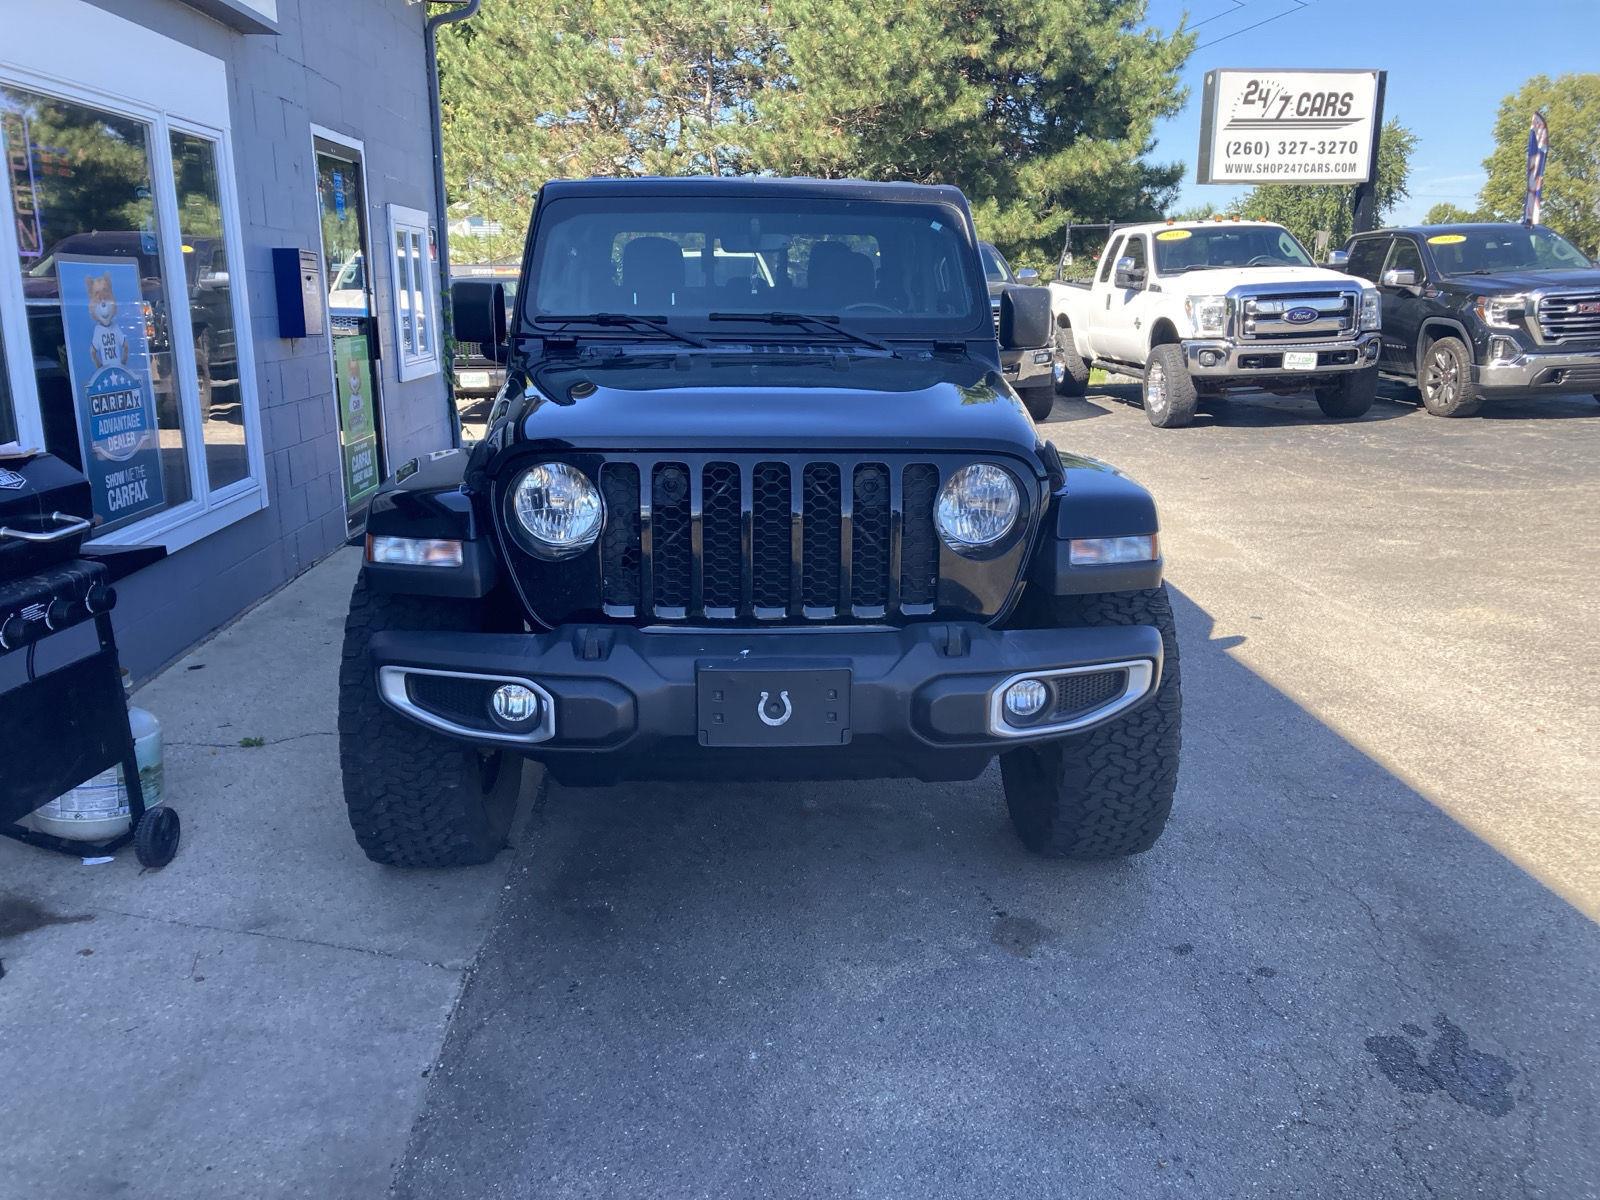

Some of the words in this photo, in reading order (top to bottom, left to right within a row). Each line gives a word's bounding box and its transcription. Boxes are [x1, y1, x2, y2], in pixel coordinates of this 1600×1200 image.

[1295, 91, 1354, 117] CARS
[1226, 141, 1270, 158] (260)
[1277, 141, 1358, 156] 327-3270
[1225, 162, 1357, 174] WWW.SHOP247CARS.COM
[101, 332, 116, 346] CAR
[104, 346, 118, 360] FOX
[92, 390, 141, 413] CARFAX
[98, 412, 142, 435] ADVANTAGE
[107, 431, 136, 452] DEALER
[105, 469, 126, 489] SHOW
[125, 467, 135, 483] ME
[135, 464, 147, 480] THE
[107, 478, 149, 512] CARFAX
